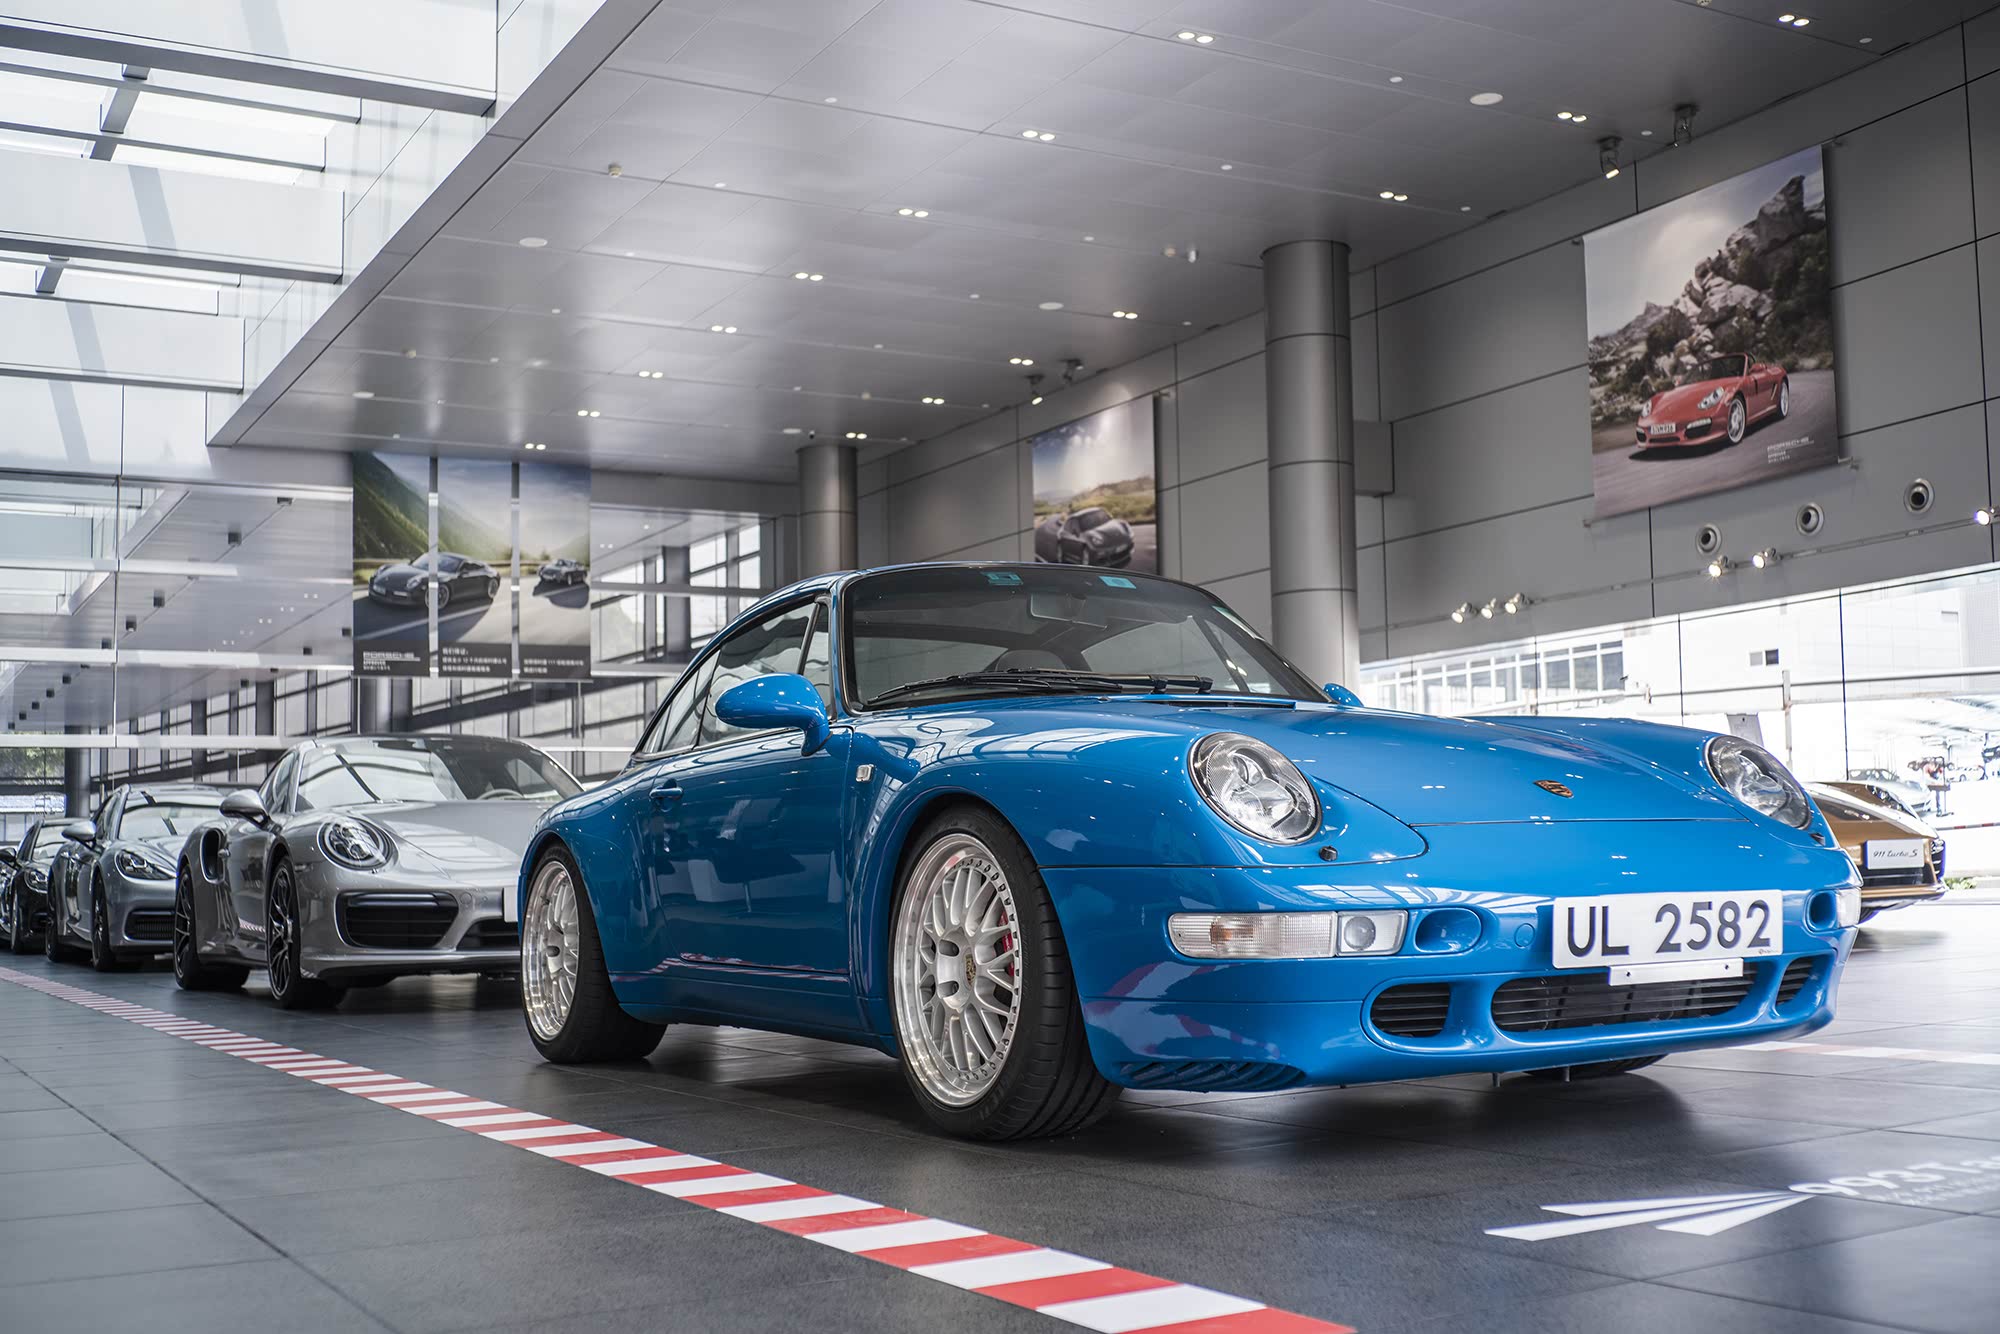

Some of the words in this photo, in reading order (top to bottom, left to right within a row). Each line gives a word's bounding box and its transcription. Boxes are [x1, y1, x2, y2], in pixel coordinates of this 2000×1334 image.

[1873, 850, 1886, 858] 911
[1909, 848, 1919, 858] S
[1567, 905, 1630, 957] UL
[1654, 899, 1771, 954] 2582
